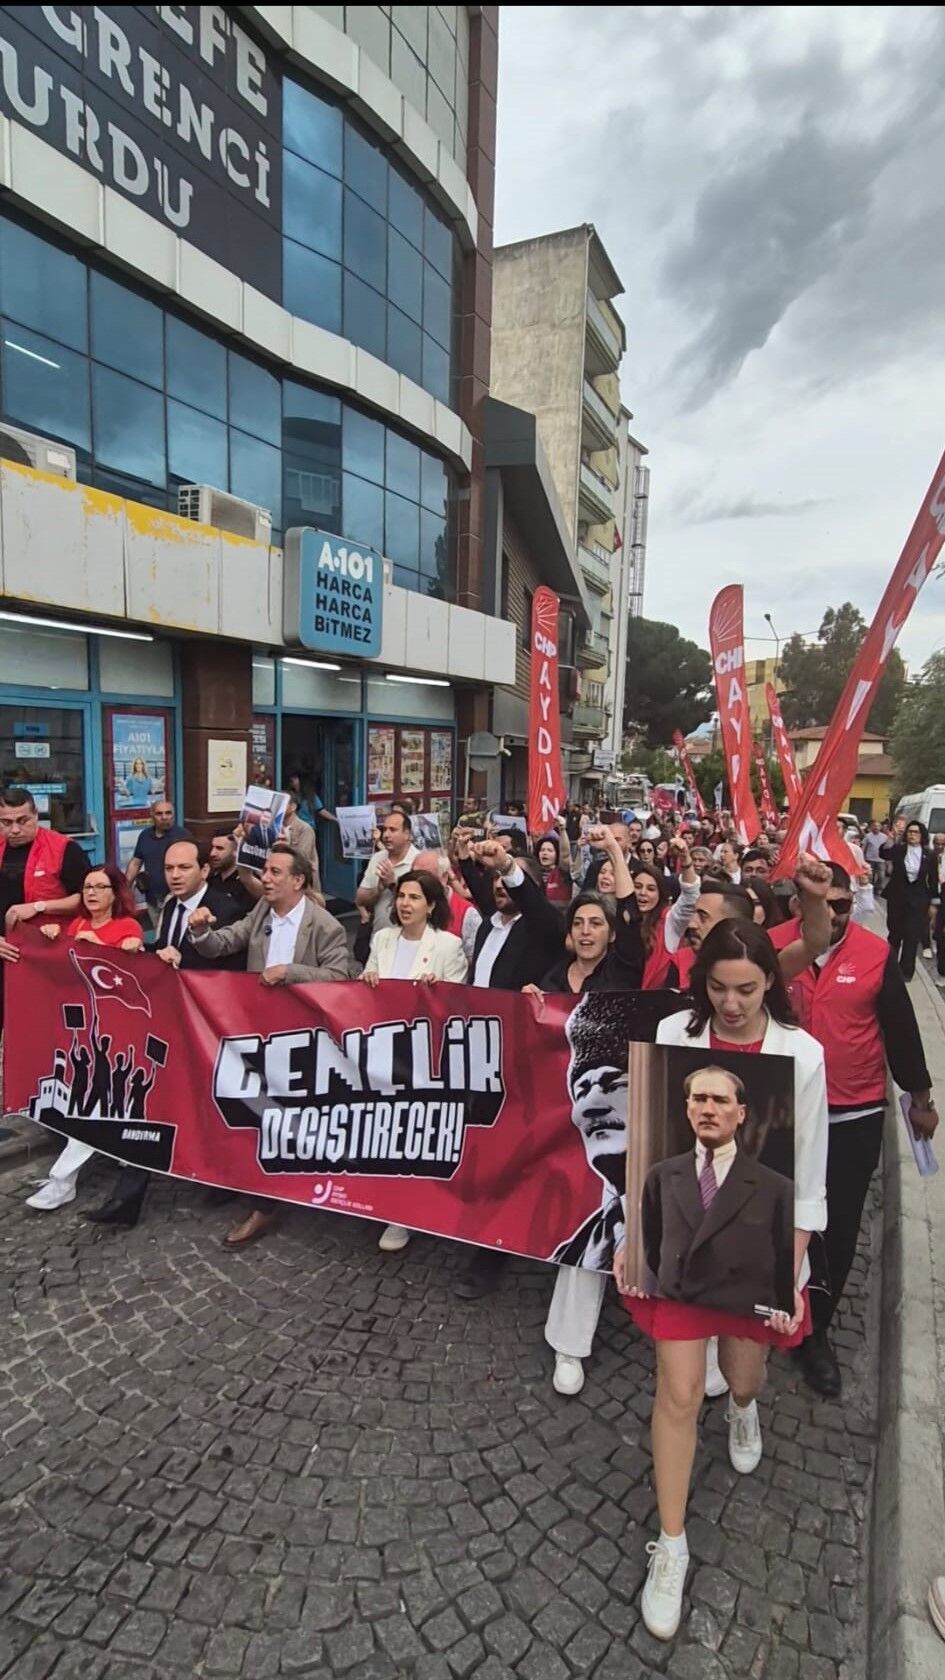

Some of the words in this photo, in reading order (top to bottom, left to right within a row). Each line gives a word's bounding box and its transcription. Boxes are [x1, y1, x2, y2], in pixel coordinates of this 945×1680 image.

[316, 571, 373, 604] HARCA
[315, 593, 372, 624] HARCA
[534, 631, 557, 658] CHP
[537, 660, 560, 823] AYDIN
